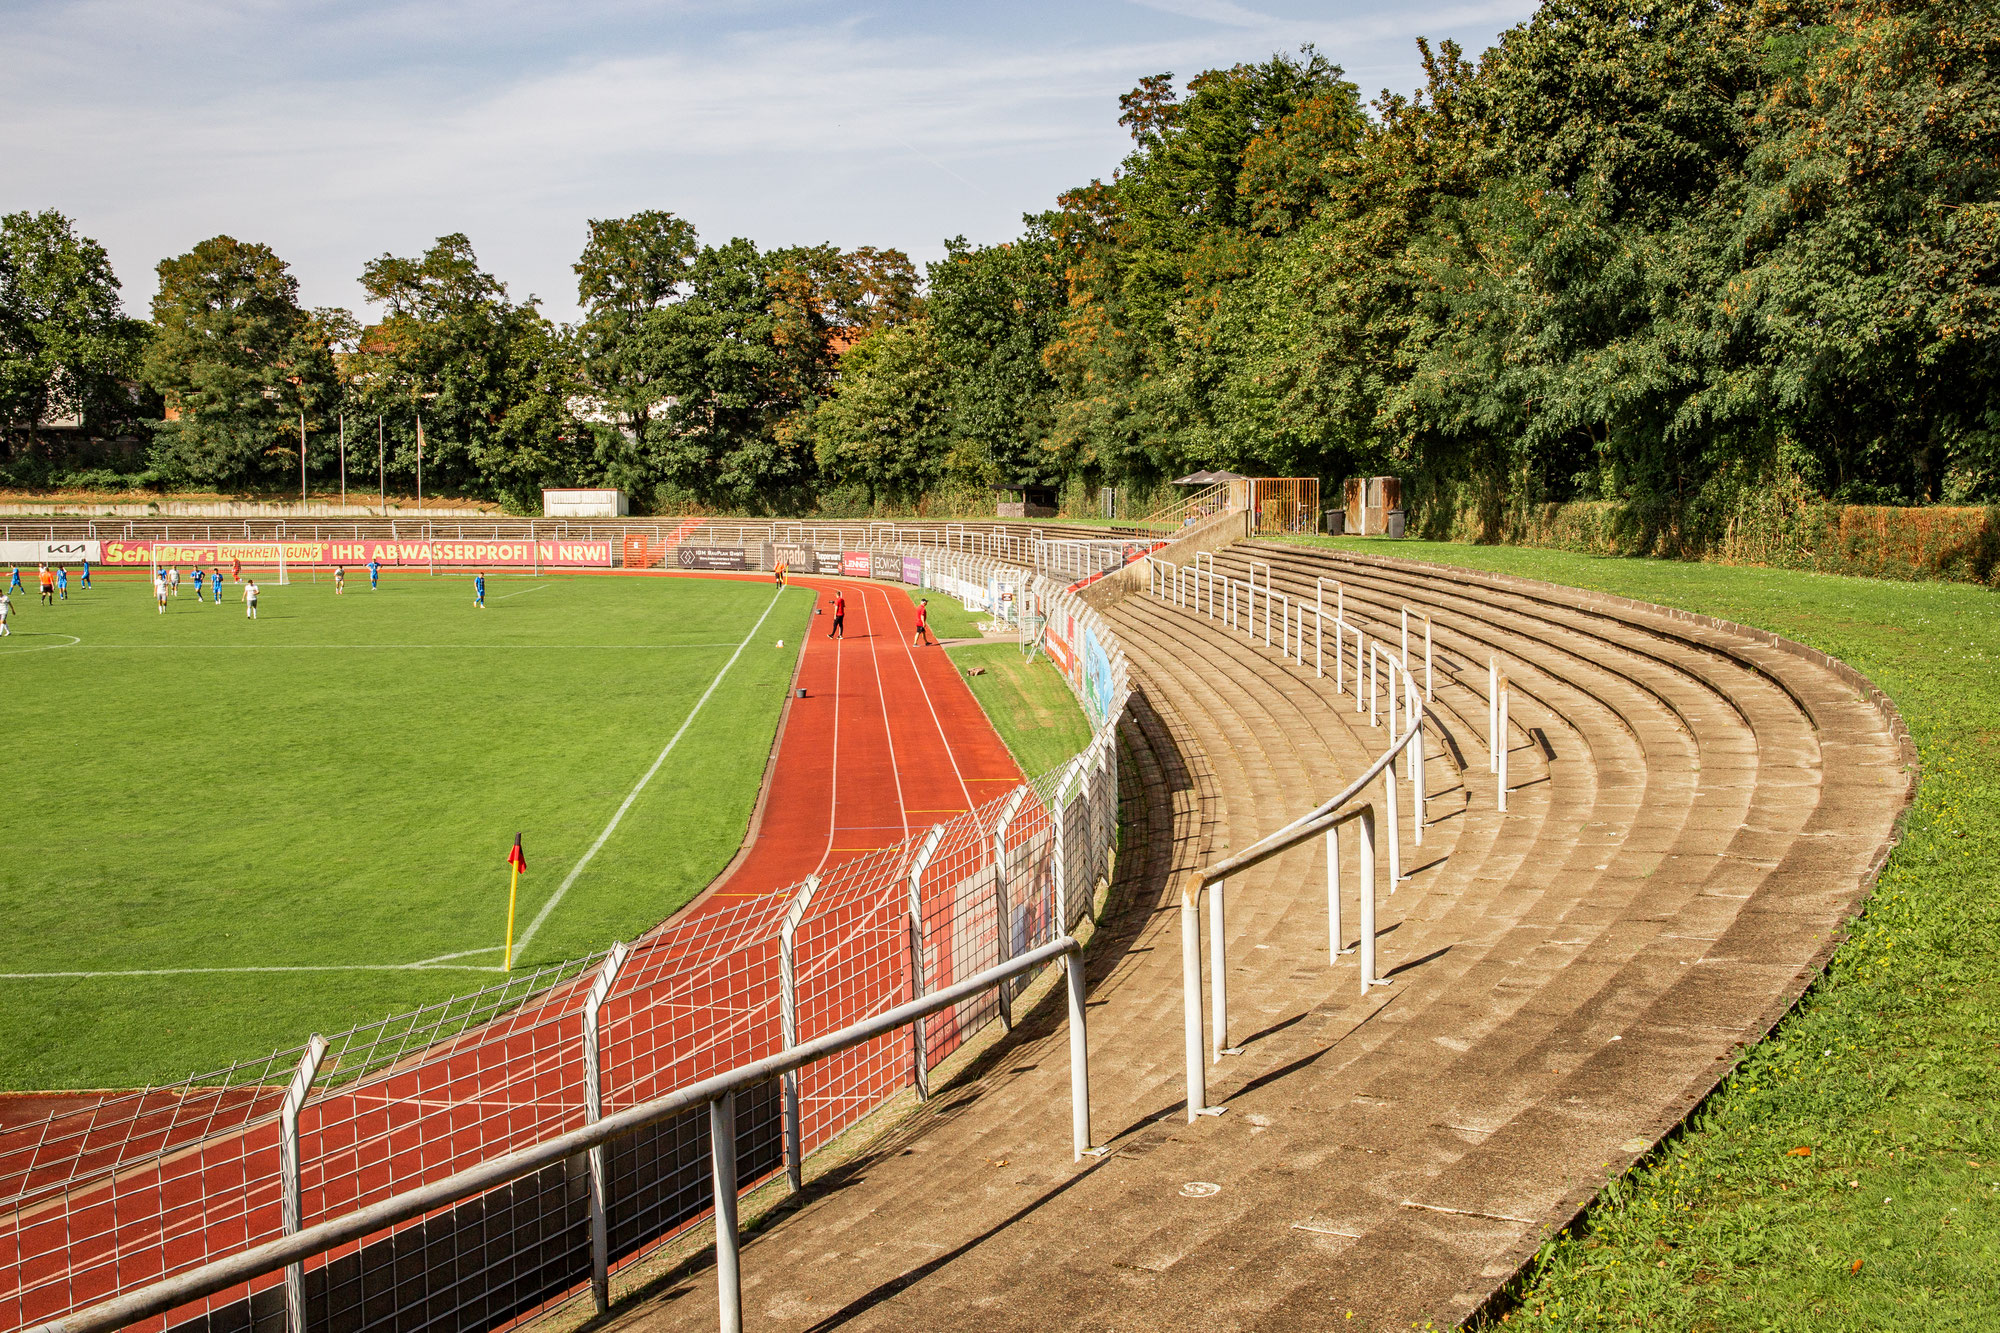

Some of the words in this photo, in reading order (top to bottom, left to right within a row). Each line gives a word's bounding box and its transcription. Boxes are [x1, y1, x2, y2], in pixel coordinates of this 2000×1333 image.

[47, 544, 86, 553] KIA
[332, 544, 366, 560] IHR
[372, 544, 528, 561] ABWASSERPROFI
[560, 545, 607, 561] NRW!
